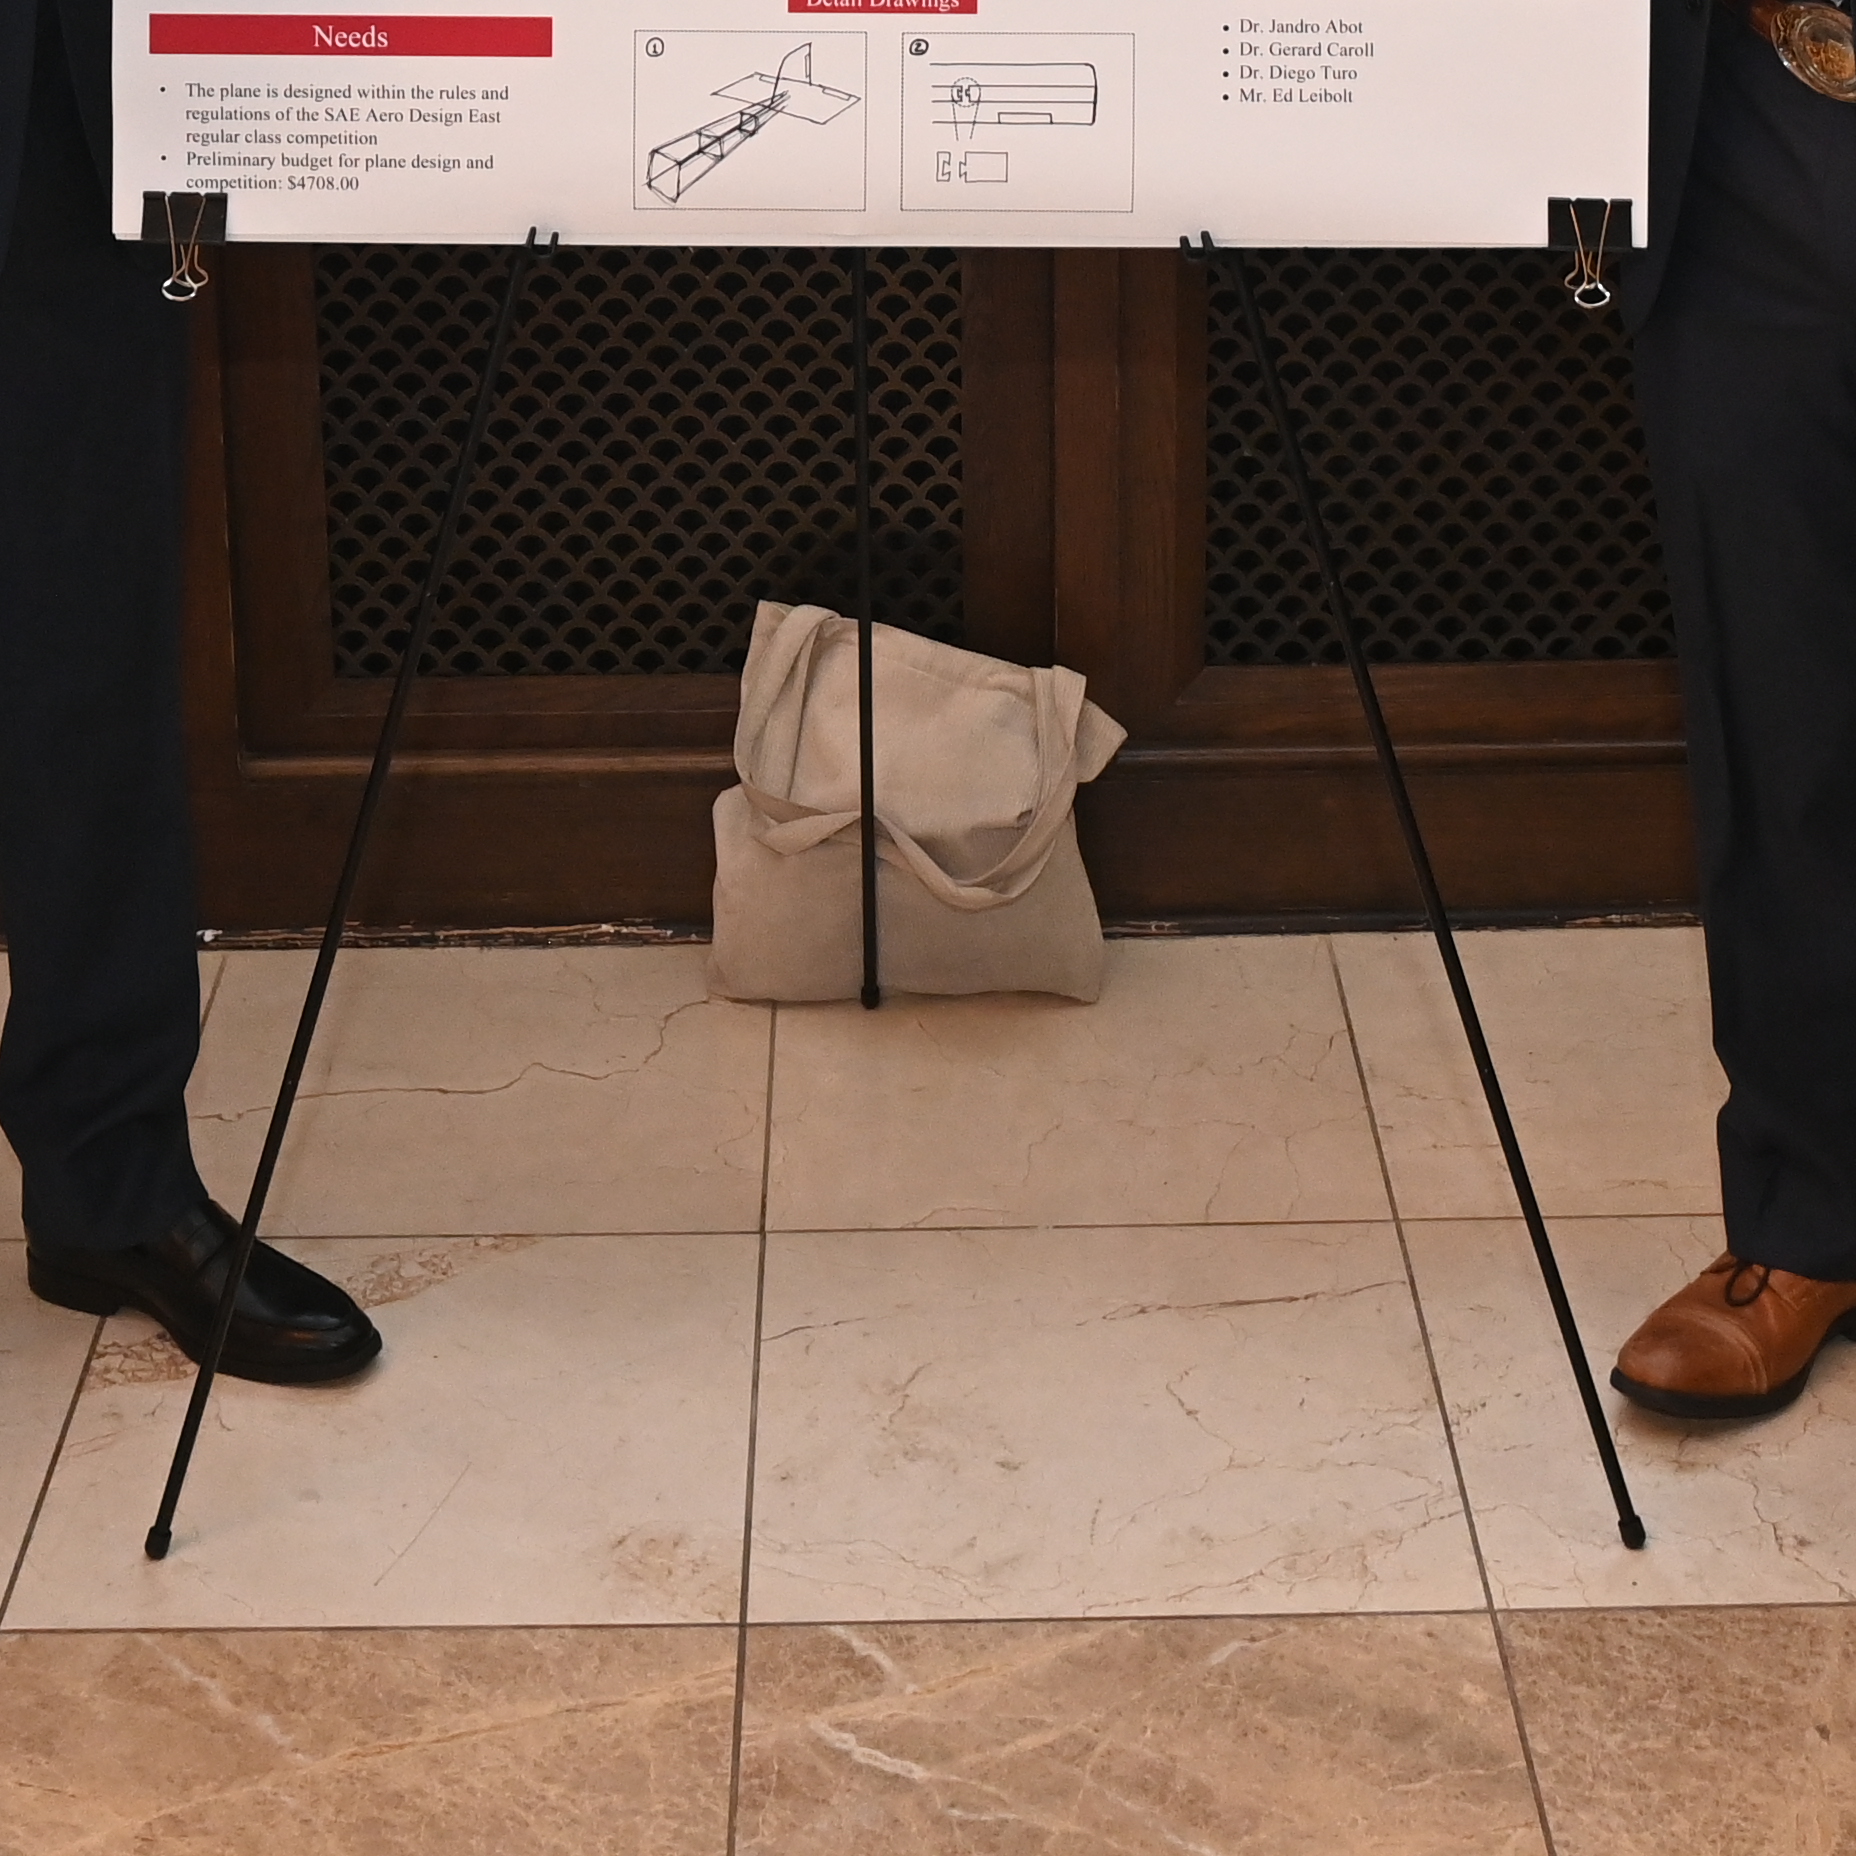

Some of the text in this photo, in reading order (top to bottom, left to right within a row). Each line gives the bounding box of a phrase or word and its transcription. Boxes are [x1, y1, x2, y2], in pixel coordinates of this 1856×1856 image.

[1241, 19, 1363, 34] Dr. Jandro Abot
[313, 25, 388, 48] Needs
[1241, 42, 1374, 57] Dr. Gerard Caroll
[1240, 65, 1358, 83] Dr. Diego Turo
[1240, 88, 1352, 103] Mr. Ed Leibolt
[186, 174, 360, 192] competition: $4708.00
